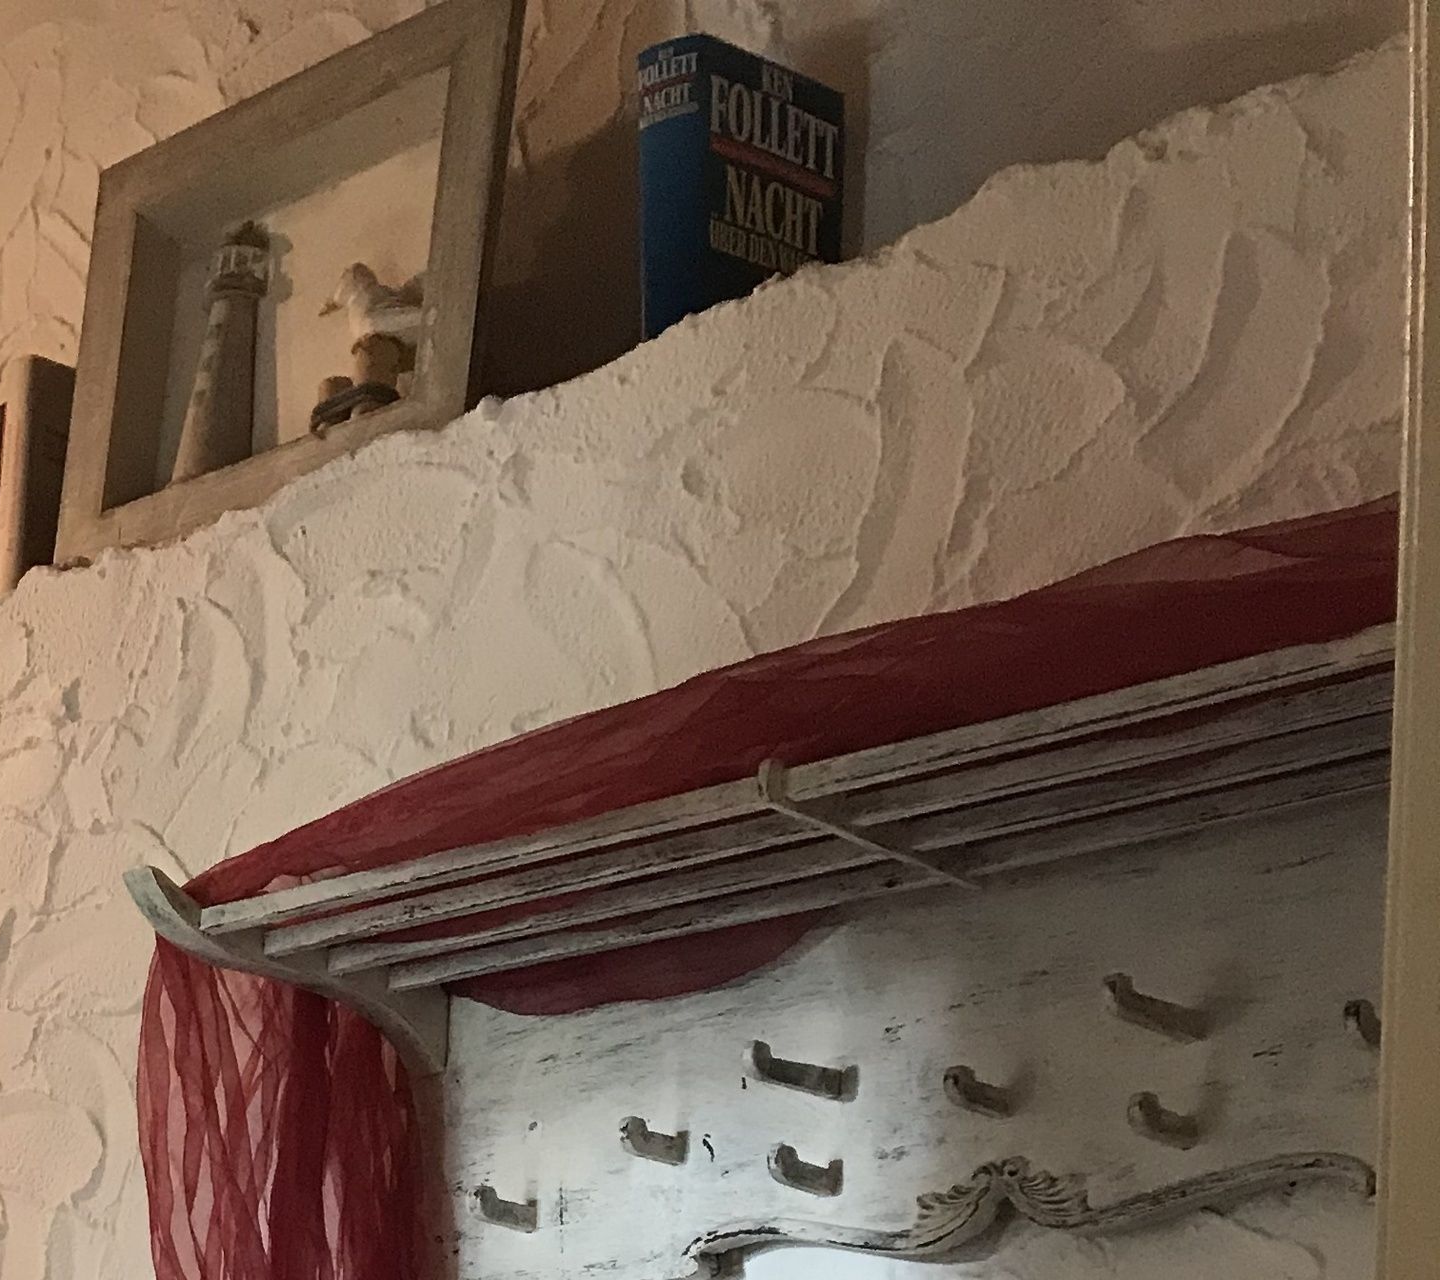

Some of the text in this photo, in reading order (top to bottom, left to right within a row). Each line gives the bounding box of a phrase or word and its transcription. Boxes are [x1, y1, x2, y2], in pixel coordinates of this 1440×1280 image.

[710, 74, 839, 179] FOLLETT
[762, 64, 794, 101] KEN
[725, 164, 824, 257] NACHT
